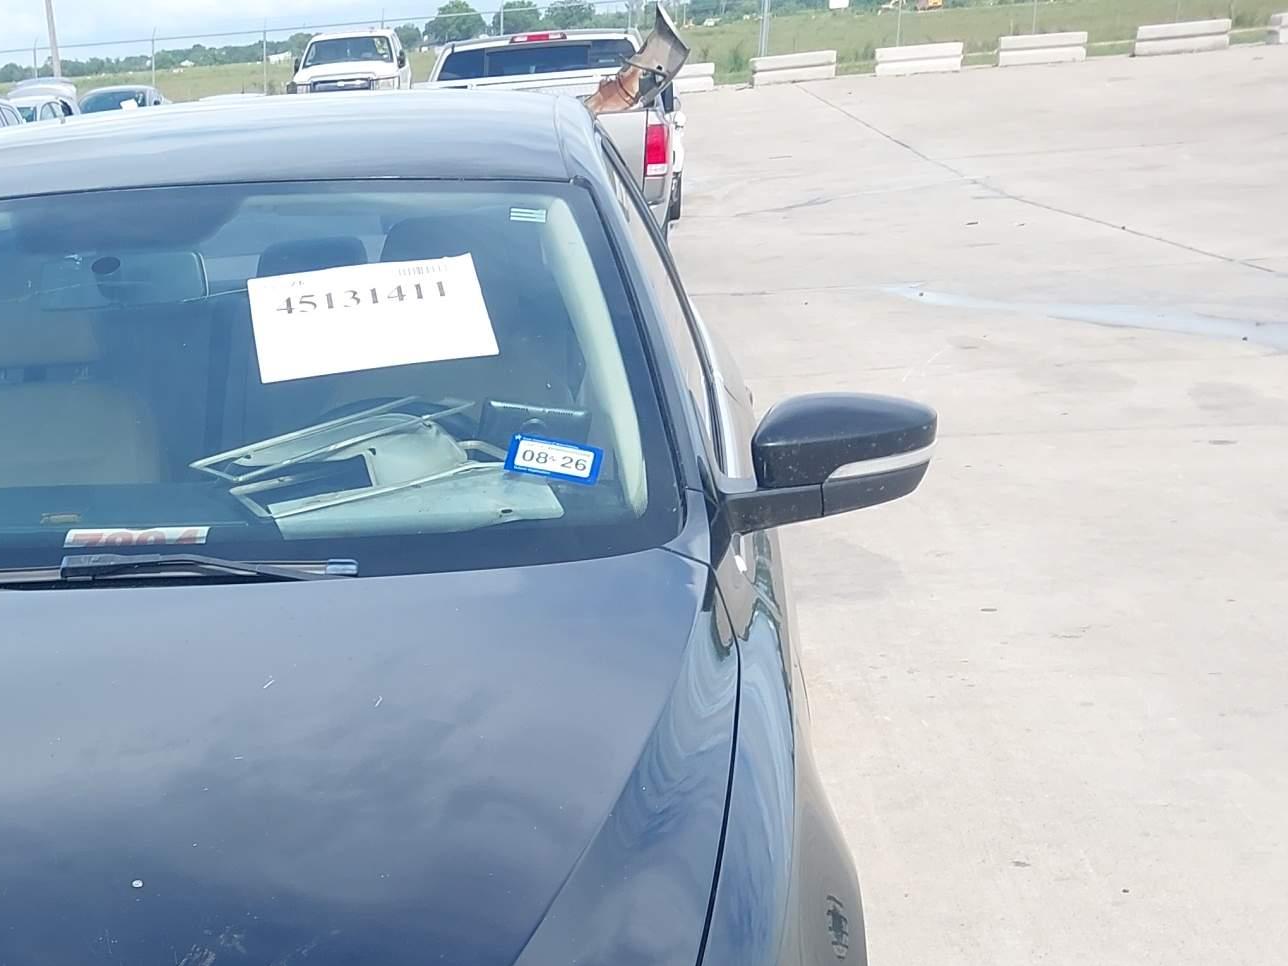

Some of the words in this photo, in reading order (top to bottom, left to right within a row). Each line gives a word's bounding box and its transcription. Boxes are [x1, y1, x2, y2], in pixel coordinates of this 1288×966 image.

[276, 281, 446, 314] 45131411
[521, 449, 549, 465] 08
[559, 455, 588, 472] 26
